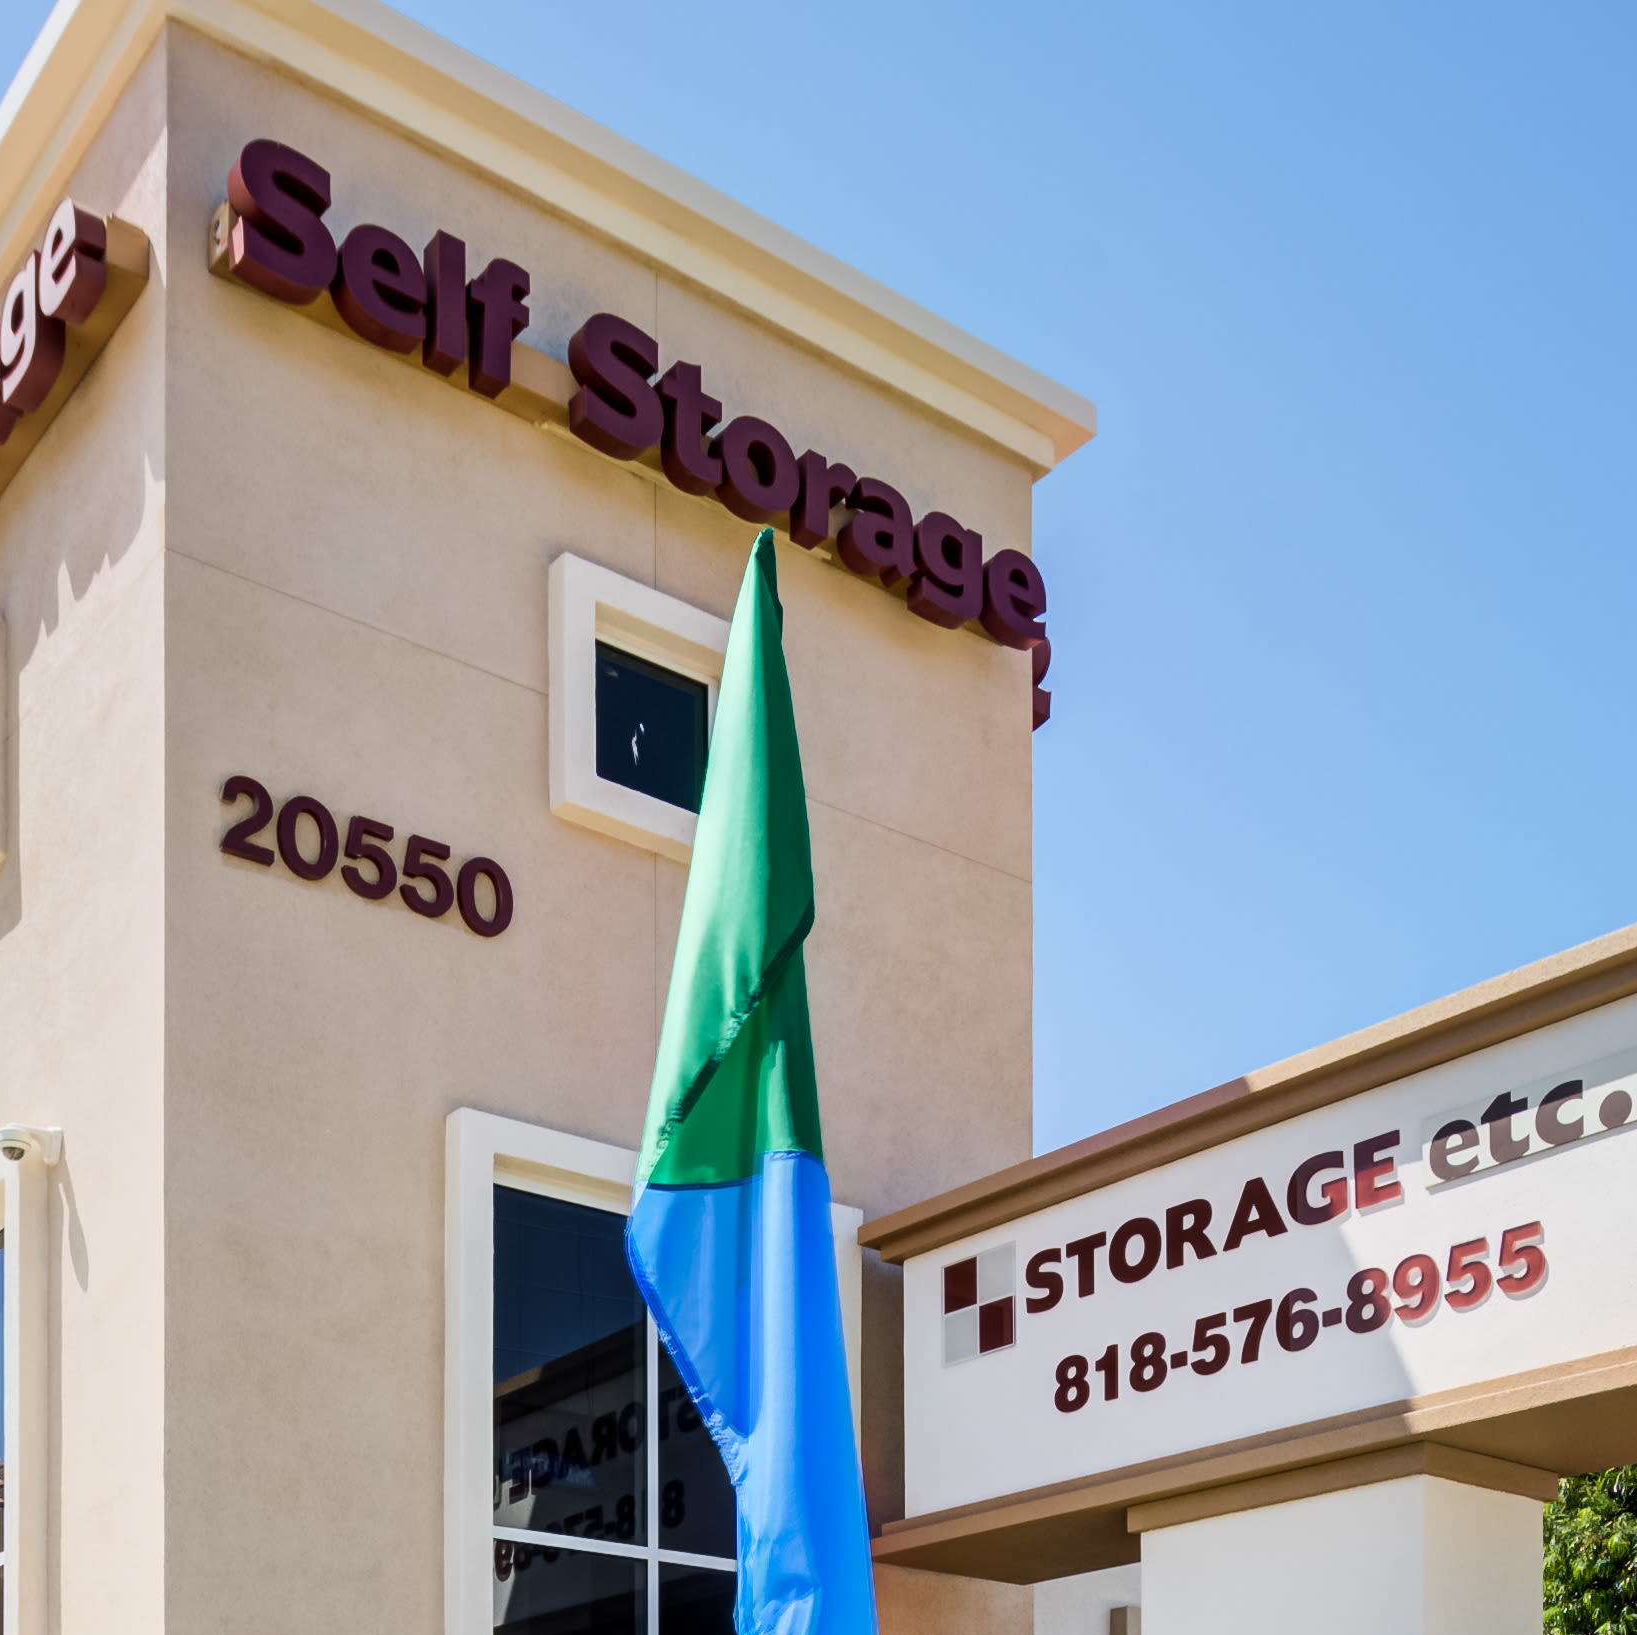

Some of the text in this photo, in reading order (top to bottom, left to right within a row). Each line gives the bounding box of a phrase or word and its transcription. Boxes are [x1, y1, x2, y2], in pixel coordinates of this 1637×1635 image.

[227, 138, 1048, 651] Self Storage
[219, 775, 514, 938] 20550
[1025, 1128, 1402, 1316] STORAGE
[1053, 1220, 1547, 1414] 818-576-8955
